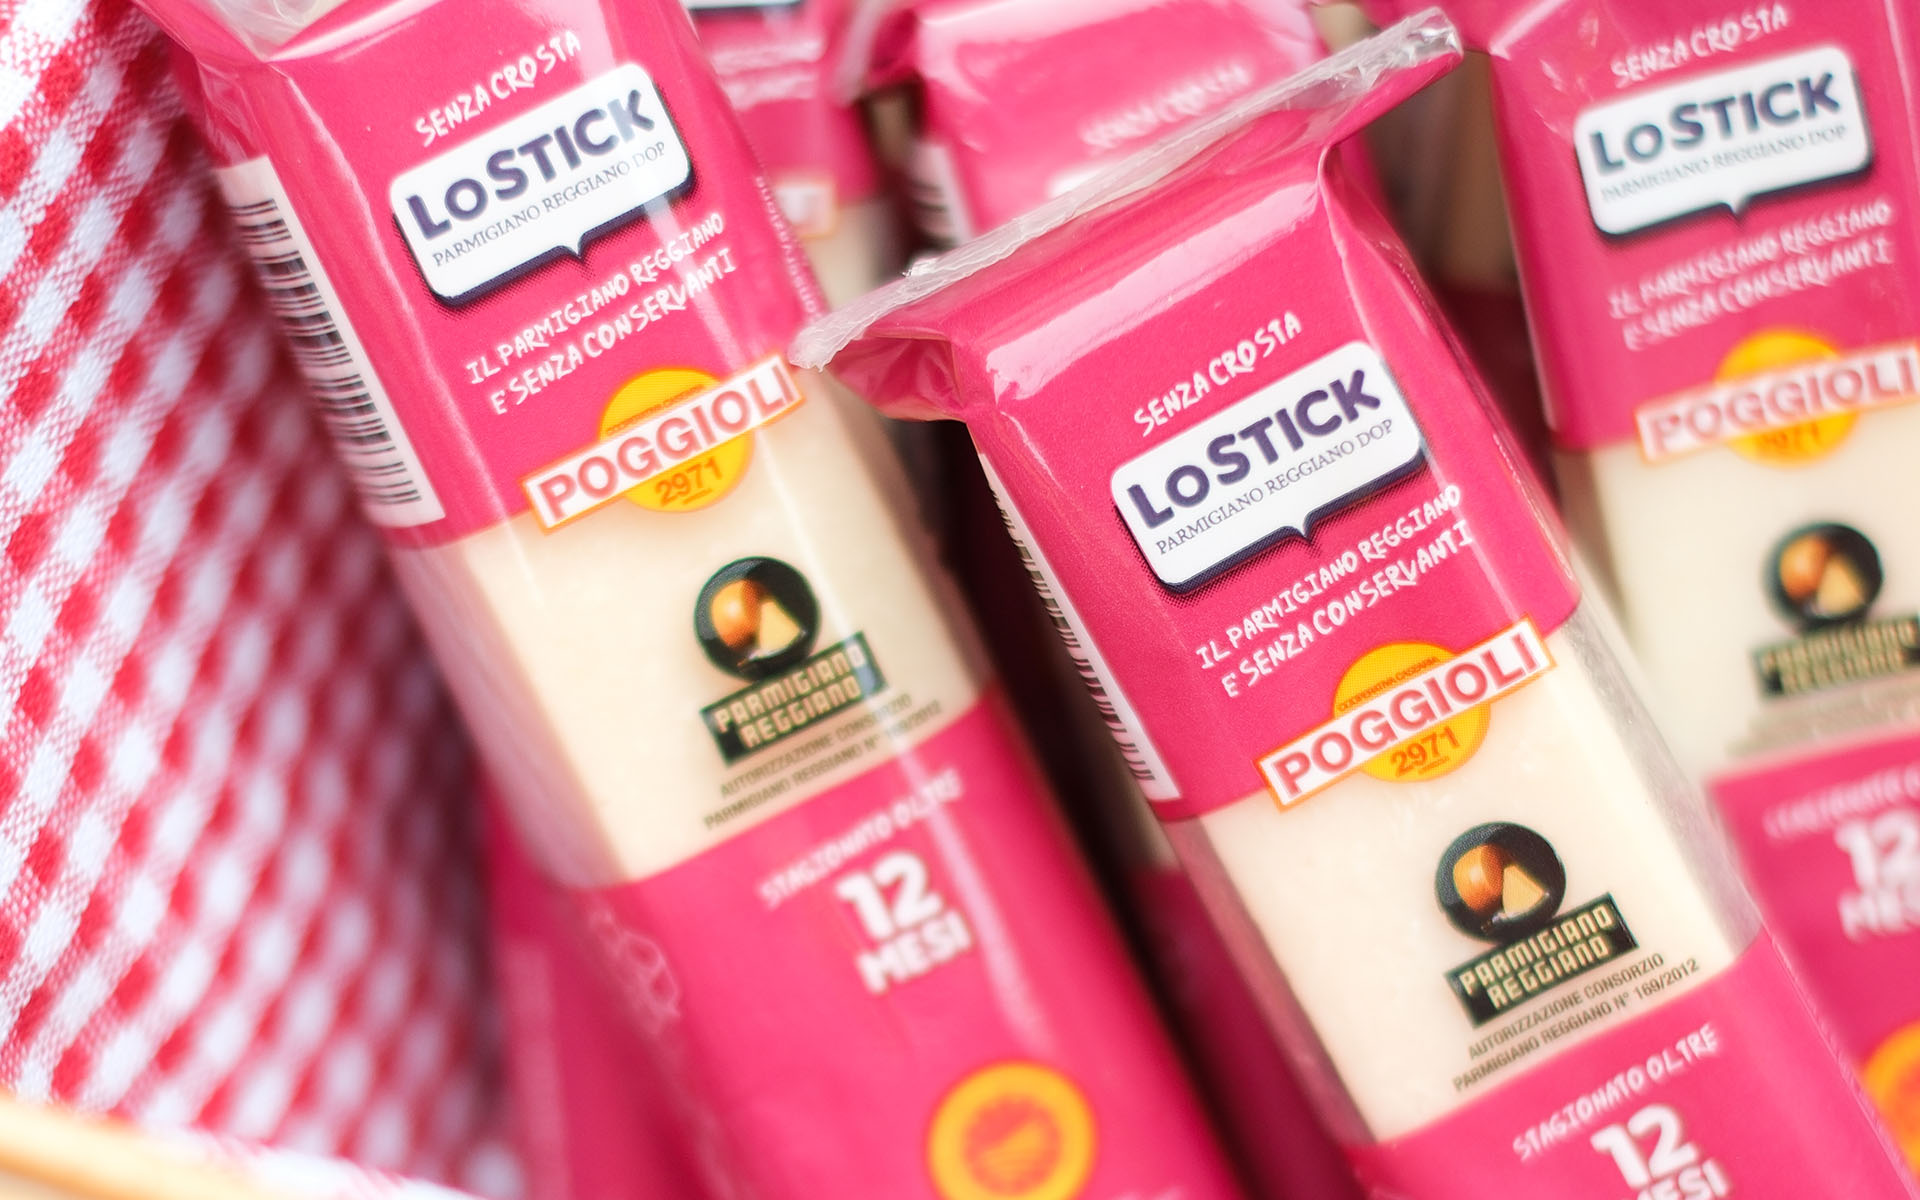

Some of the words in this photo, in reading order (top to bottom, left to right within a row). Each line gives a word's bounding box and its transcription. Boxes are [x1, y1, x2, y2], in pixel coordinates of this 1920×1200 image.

[416, 84, 491, 147] SENZA
[489, 31, 581, 101] CROSTA
[1610, 38, 1688, 88] SENZA
[1691, 4, 1789, 58] CROSTA
[432, 206, 541, 267] PARMIGIANO
[543, 160, 630, 213] REGGIANO
[632, 140, 666, 169] DOP
[466, 355, 501, 385] IL
[498, 274, 630, 366] PARMIGIANO
[630, 213, 724, 286] REGGIANO
[509, 344, 584, 405] SENZA
[583, 248, 736, 358] CONSERVANTI
[1718, 235, 1894, 312] CONSERVANTI
[1134, 373, 1210, 436] SENZA
[1208, 311, 1302, 386] CROSTA
[1651, 356, 1916, 457] POGGIOLI
[539, 366, 796, 520] POGGIOLI
[655, 456, 722, 506] 2971
[1155, 487, 1264, 555] PARMIGIANO
[1264, 439, 1354, 496] REGGIANO
[1355, 419, 1394, 452] DOP
[1196, 640, 1230, 669] IL
[1226, 551, 1358, 648] PARMIGIANO
[1358, 484, 1461, 562] REGGIANO
[1239, 623, 1314, 687] SENZA
[1312, 520, 1473, 635] CONSERVANTI
[713, 643, 866, 733] PARMIGIANO
[741, 674, 862, 748] REGGIANO
[1271, 631, 1539, 799] POGGIOLI
[1390, 726, 1460, 777] 2971
[836, 852, 944, 940] 12
[858, 910, 972, 994] MESI
[1458, 904, 1614, 996] PARMIGIANO
[1487, 936, 1610, 1010] REGGIANO
[1452, 1038, 1540, 1092] PARMIGIANO
[1542, 1001, 1613, 1044] REGGIANO
[1634, 957, 1700, 1001] 169/2012
[1468, 992, 1584, 1060] AUTORIZZAZIONE
[1583, 953, 1665, 998] CONSORZIO
[1512, 1067, 1646, 1163] STAGIONATO
[1645, 1022, 1721, 1081] OLTRE
[1590, 1104, 1699, 1189] 12
